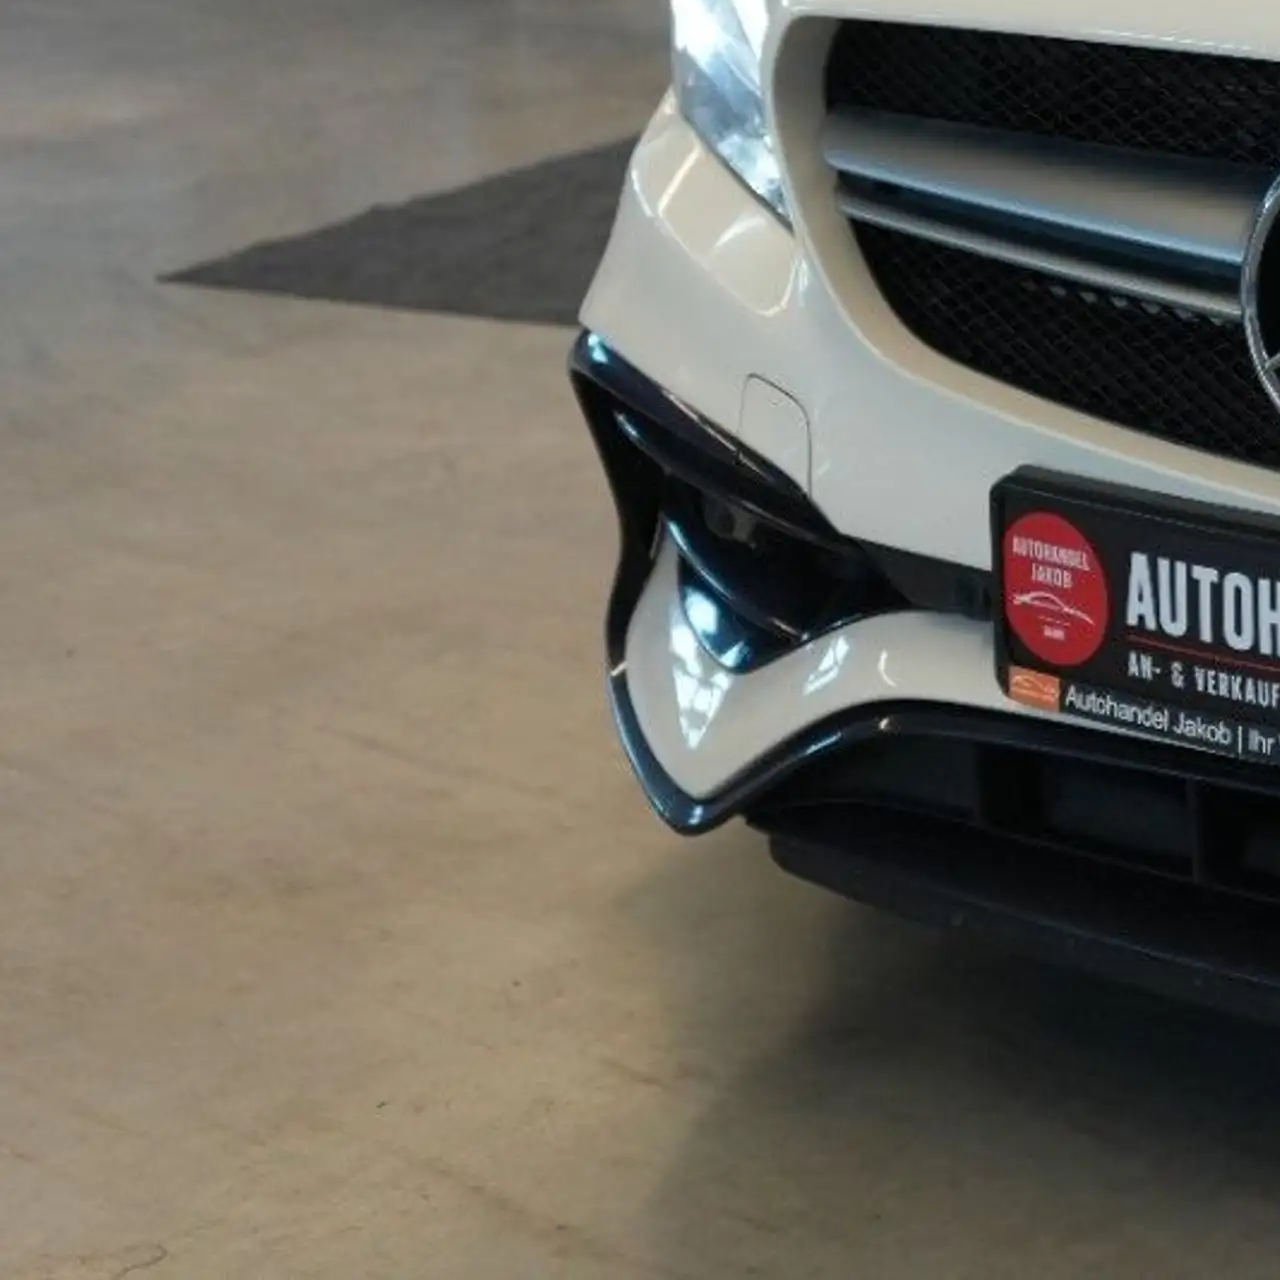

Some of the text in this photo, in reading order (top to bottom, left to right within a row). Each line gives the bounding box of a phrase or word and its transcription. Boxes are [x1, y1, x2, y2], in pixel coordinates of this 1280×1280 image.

[1127, 649, 1162, 681] AN-
[1170, 661, 1185, 690] &
[1065, 684, 1169, 733] Autohandel
[1173, 712, 1232, 746] Jakob
[1247, 728, 1275, 756] Ihr
